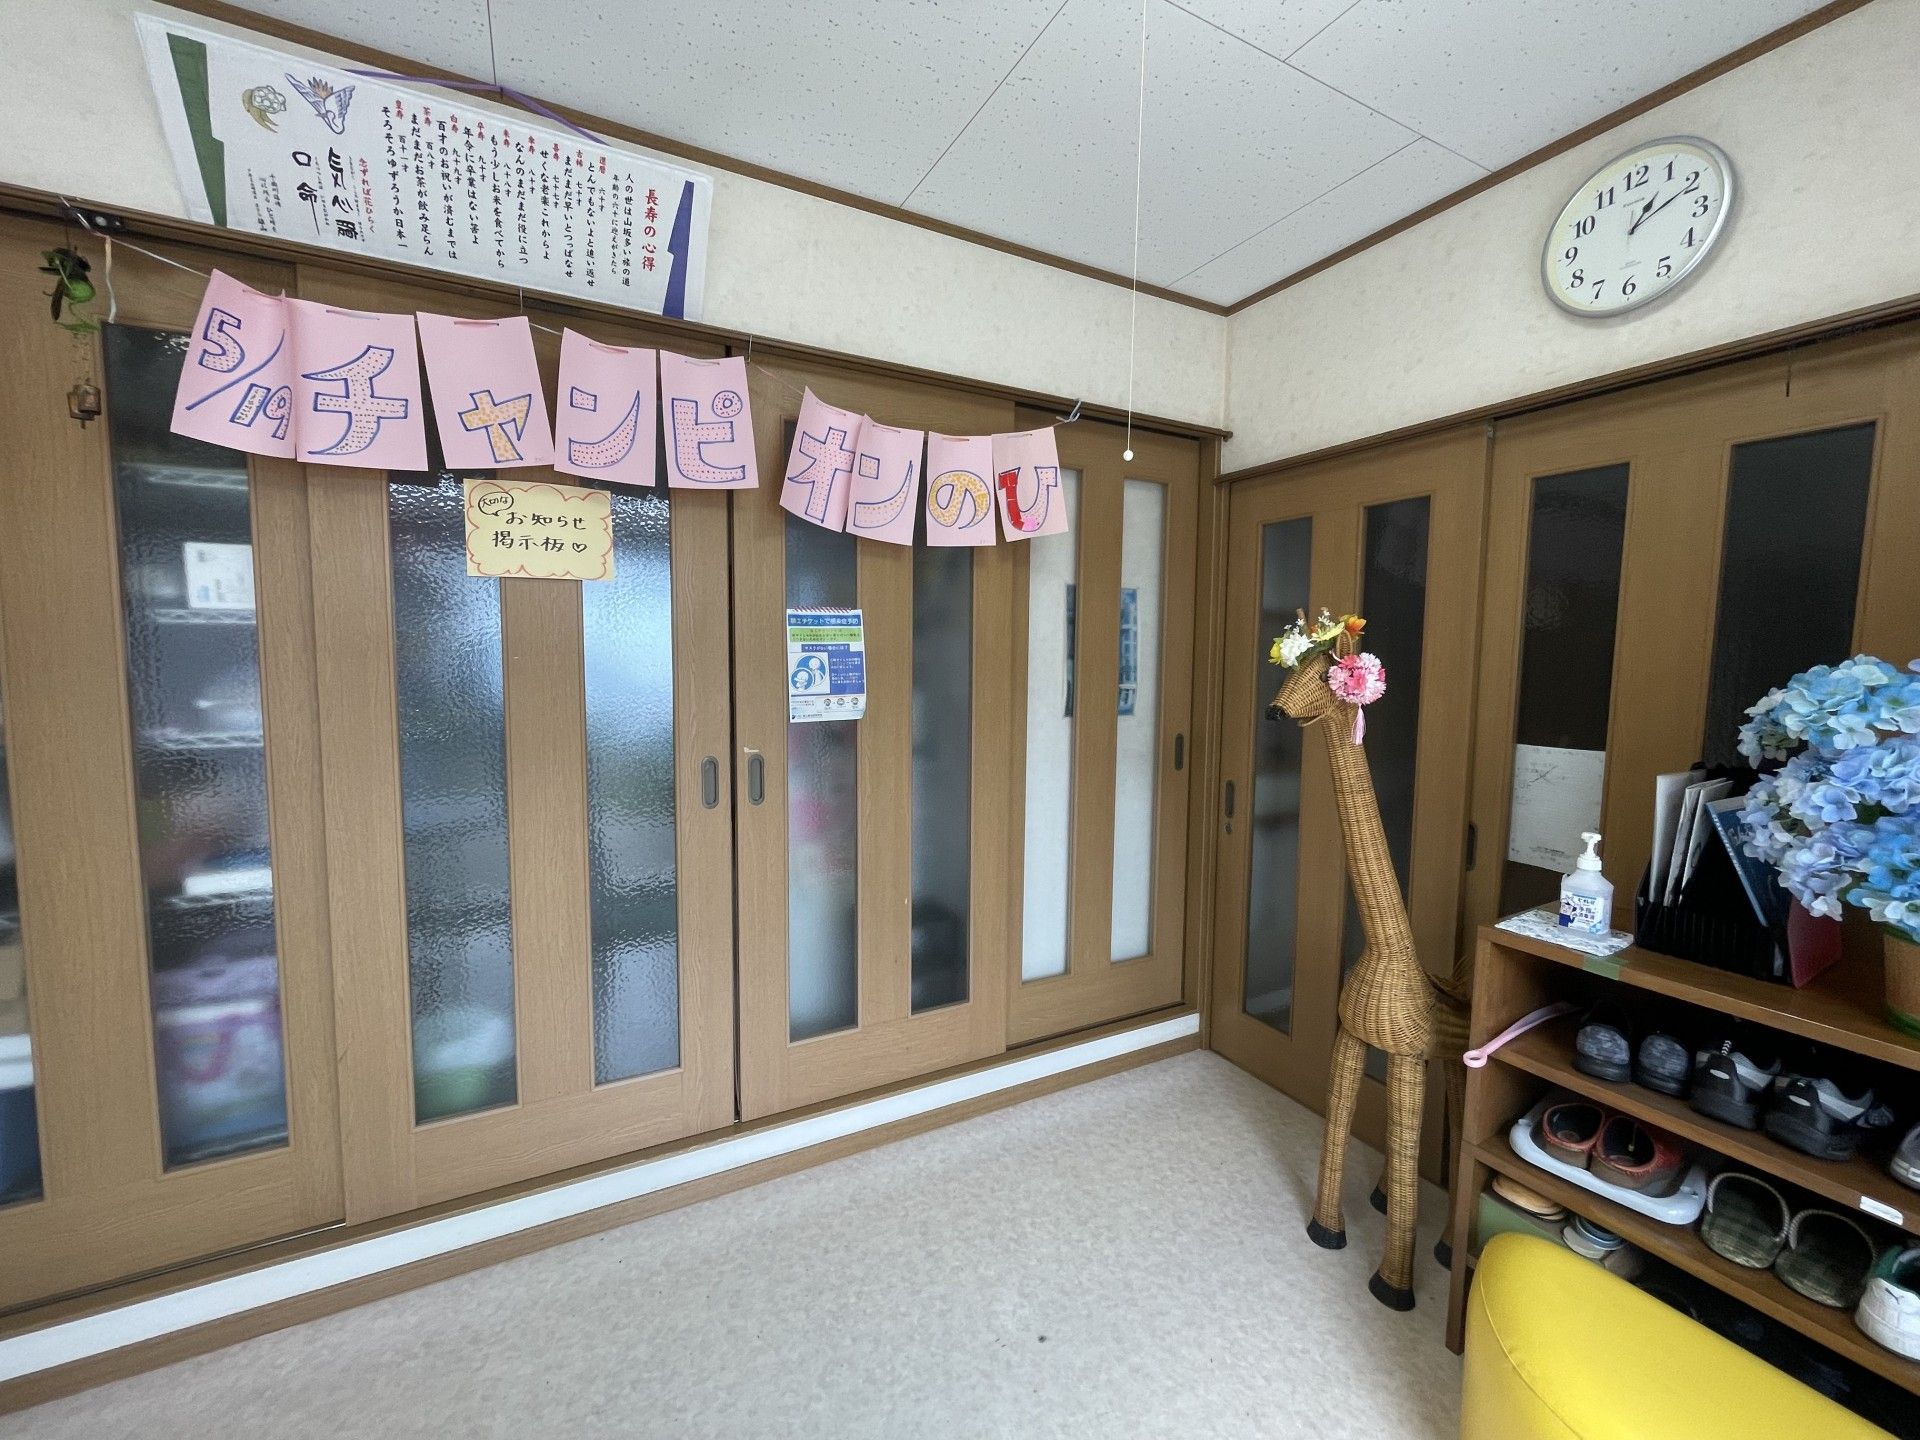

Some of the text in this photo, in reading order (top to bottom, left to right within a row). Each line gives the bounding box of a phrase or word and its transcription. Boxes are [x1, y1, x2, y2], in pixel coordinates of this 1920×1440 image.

[398, 134, 409, 173] 百十一才
[425, 141, 435, 169] 百八才
[452, 148, 462, 185] 九十九才
[381, 106, 408, 248] そろそろゆずろうか日本一
[478, 155, 486, 182] 九十才
[503, 162, 511, 197] 八十八才
[528, 169, 536, 194] 八十才
[1622, 165, 1649, 193] 12
[1663, 161, 1675, 182] 1
[359, 157, 375, 233] 念ずれば花ひらく
[411, 113, 433, 256] まだまだお茶が飲み足らん
[436, 120, 458, 260] 百才のお祝いが済むまでは
[552, 175, 560, 209] 七十七才
[575, 181, 583, 206] 七十才
[1683, 171, 1700, 195] 2
[491, 134, 505, 269] もう少しお米を食べてから
[515, 141, 528, 264] なんのまだまだ役に立つ
[1594, 186, 1616, 211] 11
[1692, 195, 1709, 218] 3
[564, 155, 574, 278] まだまだ早いとつっぱなせ
[586, 161, 597, 287] とんでもないよと追い返せ
[622, 173, 634, 287] 人の世は山坂多い旅の道
[641, 188, 659, 271] 長寿の心得
[1572, 215, 1596, 240] 10
[1680, 227, 1696, 249] 4
[1564, 246, 1578, 267] 9
[1656, 256, 1672, 278] 5
[1570, 268, 1585, 289] 8
[1591, 279, 1606, 300] 7
[1622, 274, 1637, 297] 6
[481, 495, 508, 508] 大切な
[505, 511, 587, 530] お知らせ
[492, 530, 565, 553] 掲示板
